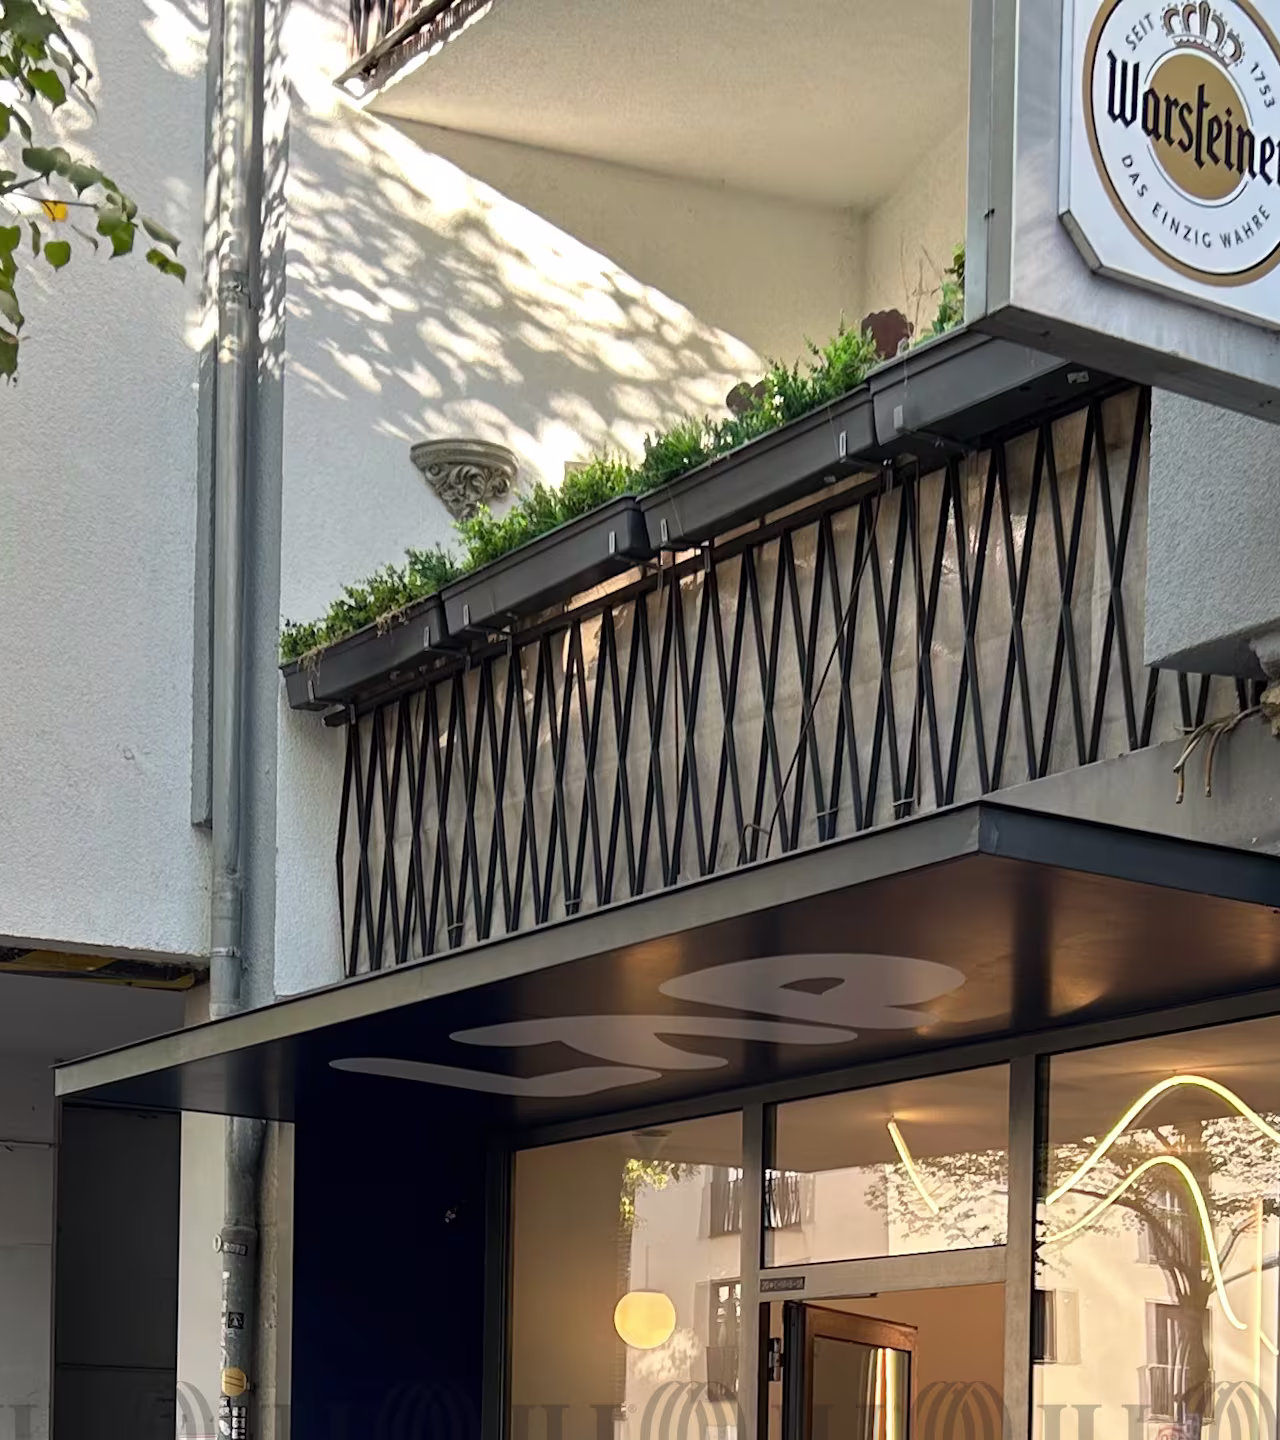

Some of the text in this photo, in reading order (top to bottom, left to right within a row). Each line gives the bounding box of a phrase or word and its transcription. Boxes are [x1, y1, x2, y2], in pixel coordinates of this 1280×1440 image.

[1125, 13, 1276, 108] SEIT 1753
[1121, 154, 1271, 249] DAS EINZIG WAHRE
